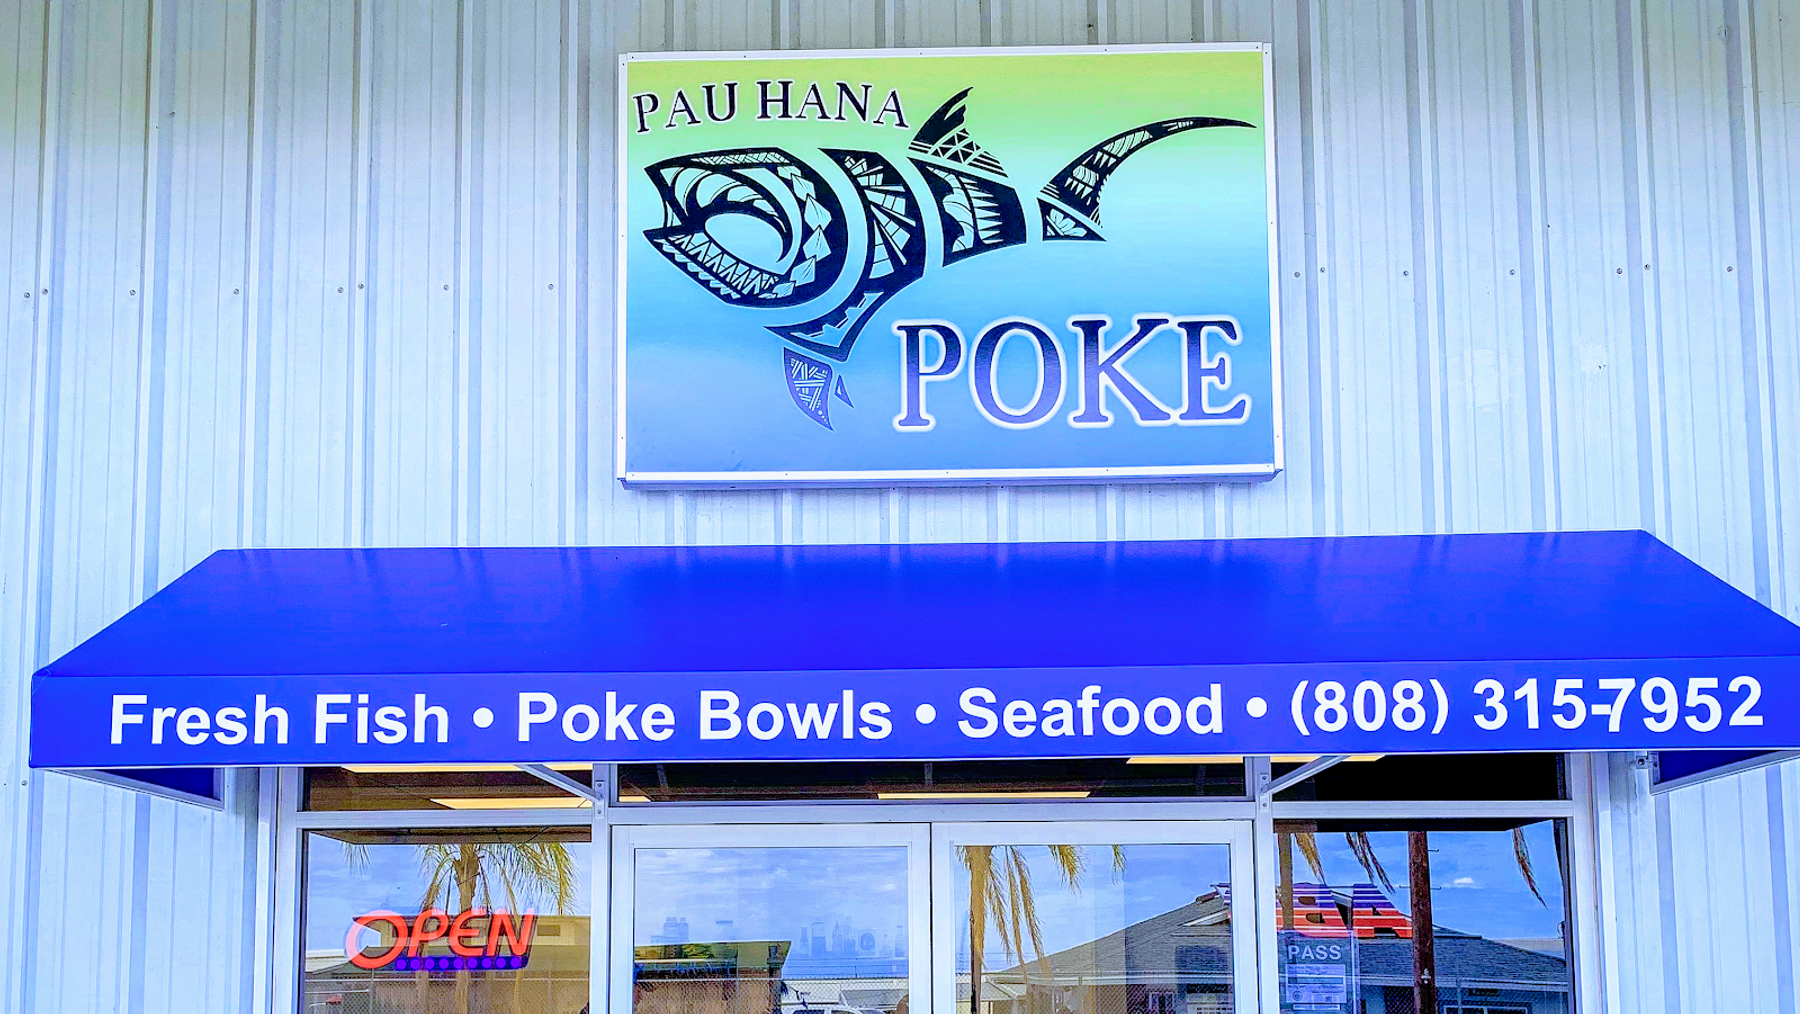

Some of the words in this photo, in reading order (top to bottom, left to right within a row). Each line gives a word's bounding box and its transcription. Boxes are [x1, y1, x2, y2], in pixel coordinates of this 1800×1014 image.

[632, 82, 738, 133] PAU
[756, 80, 909, 128] HANA
[896, 318, 1247, 426] POKE
[111, 694, 289, 745] Fresh
[314, 693, 449, 744] Fish
[518, 692, 676, 742] Poke
[700, 690, 893, 741] Bowls
[957, 684, 1223, 739] Seafood
[1291, 679, 1449, 736] (808)
[1473, 675, 1764, 733] 315-7952
[345, 907, 536, 969] OPEN
[1287, 945, 1342, 960] PASS
